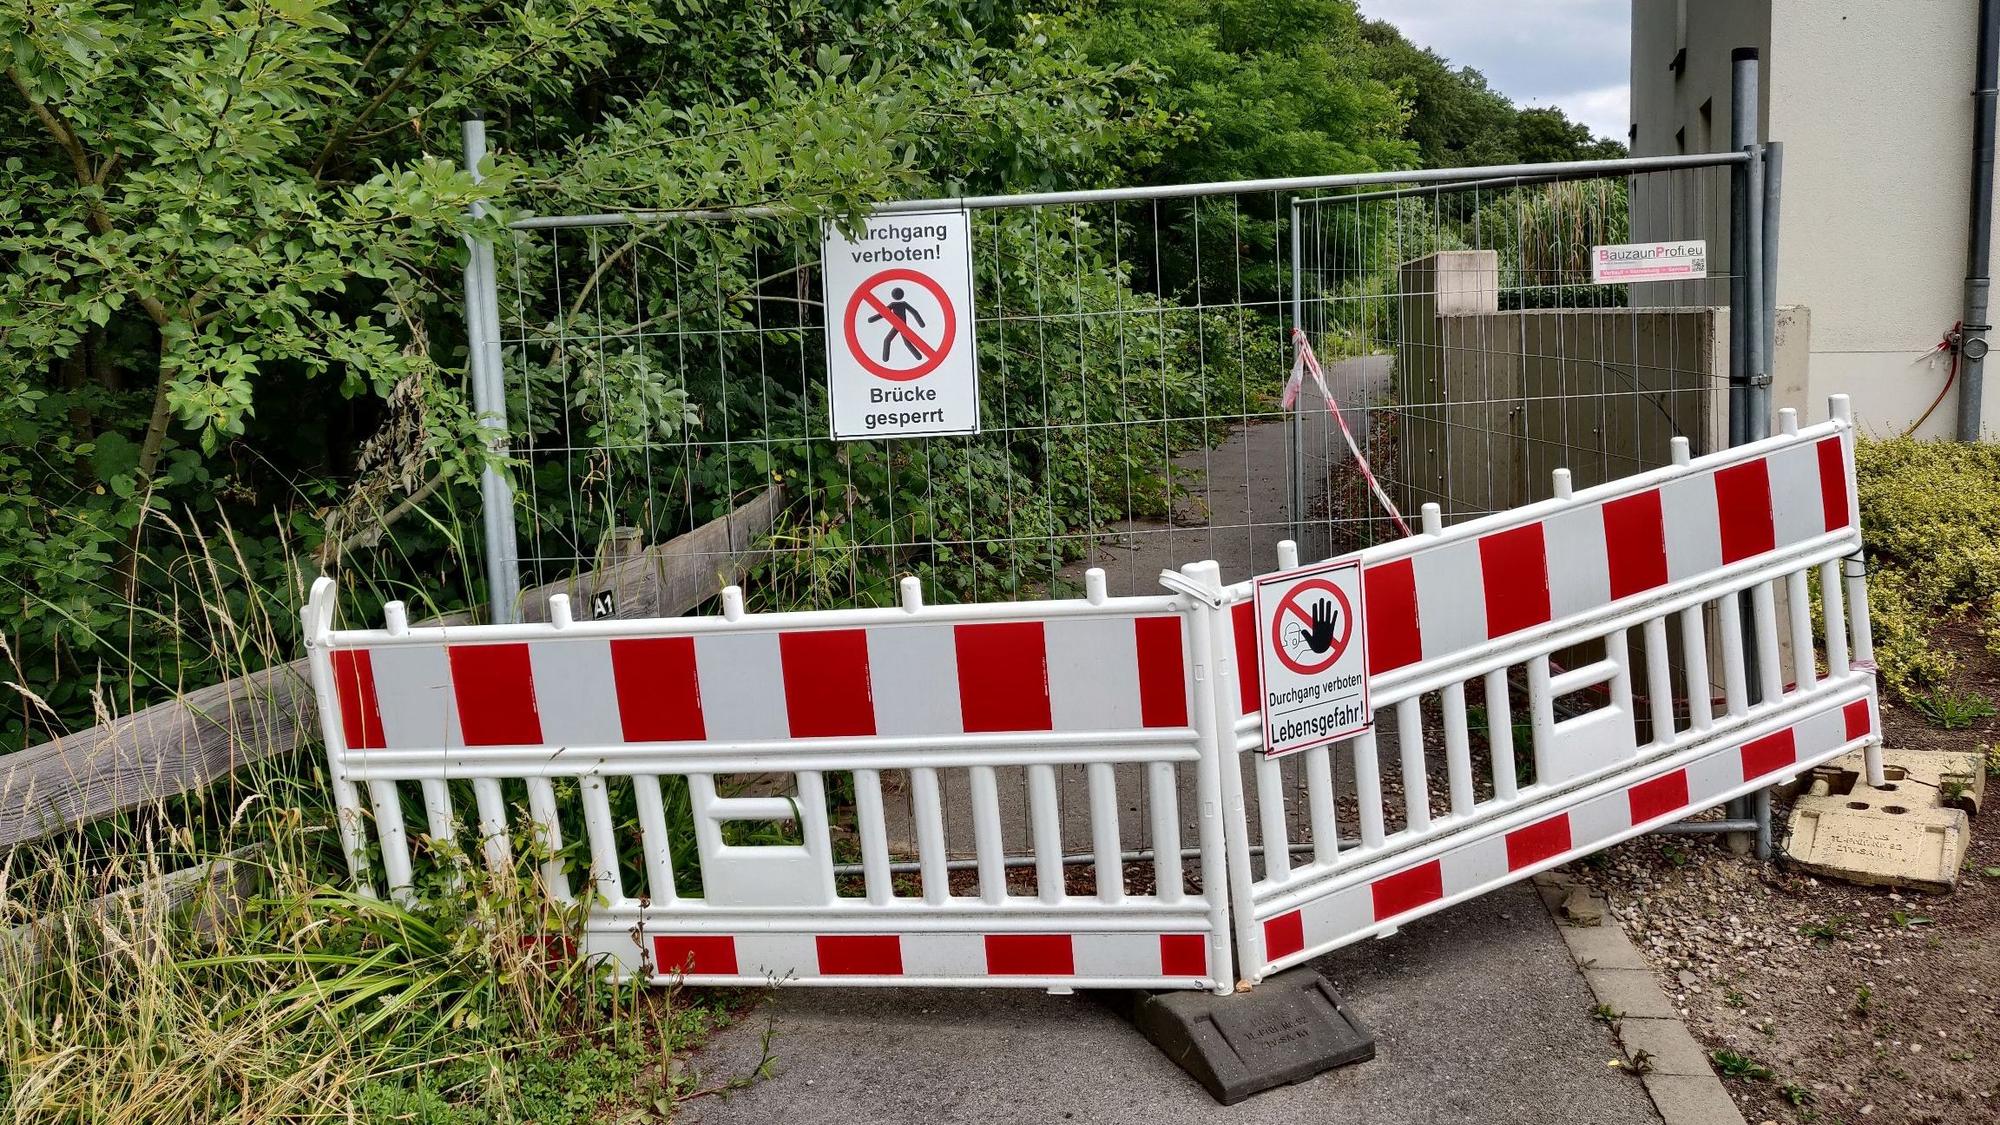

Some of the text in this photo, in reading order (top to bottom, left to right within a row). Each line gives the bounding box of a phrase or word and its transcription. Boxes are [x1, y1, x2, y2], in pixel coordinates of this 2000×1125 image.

[845, 224, 947, 243] rchgang
[851, 244, 940, 263] verboten!
[1600, 245, 1703, 261] BauzaunProfi.eu
[870, 386, 937, 404] Brücke
[865, 408, 944, 429] gesperrt
[594, 594, 613, 618] A1
[1269, 674, 1362, 707] Durchgang verboten
[1271, 701, 1364, 744] Lebensgefahr!
